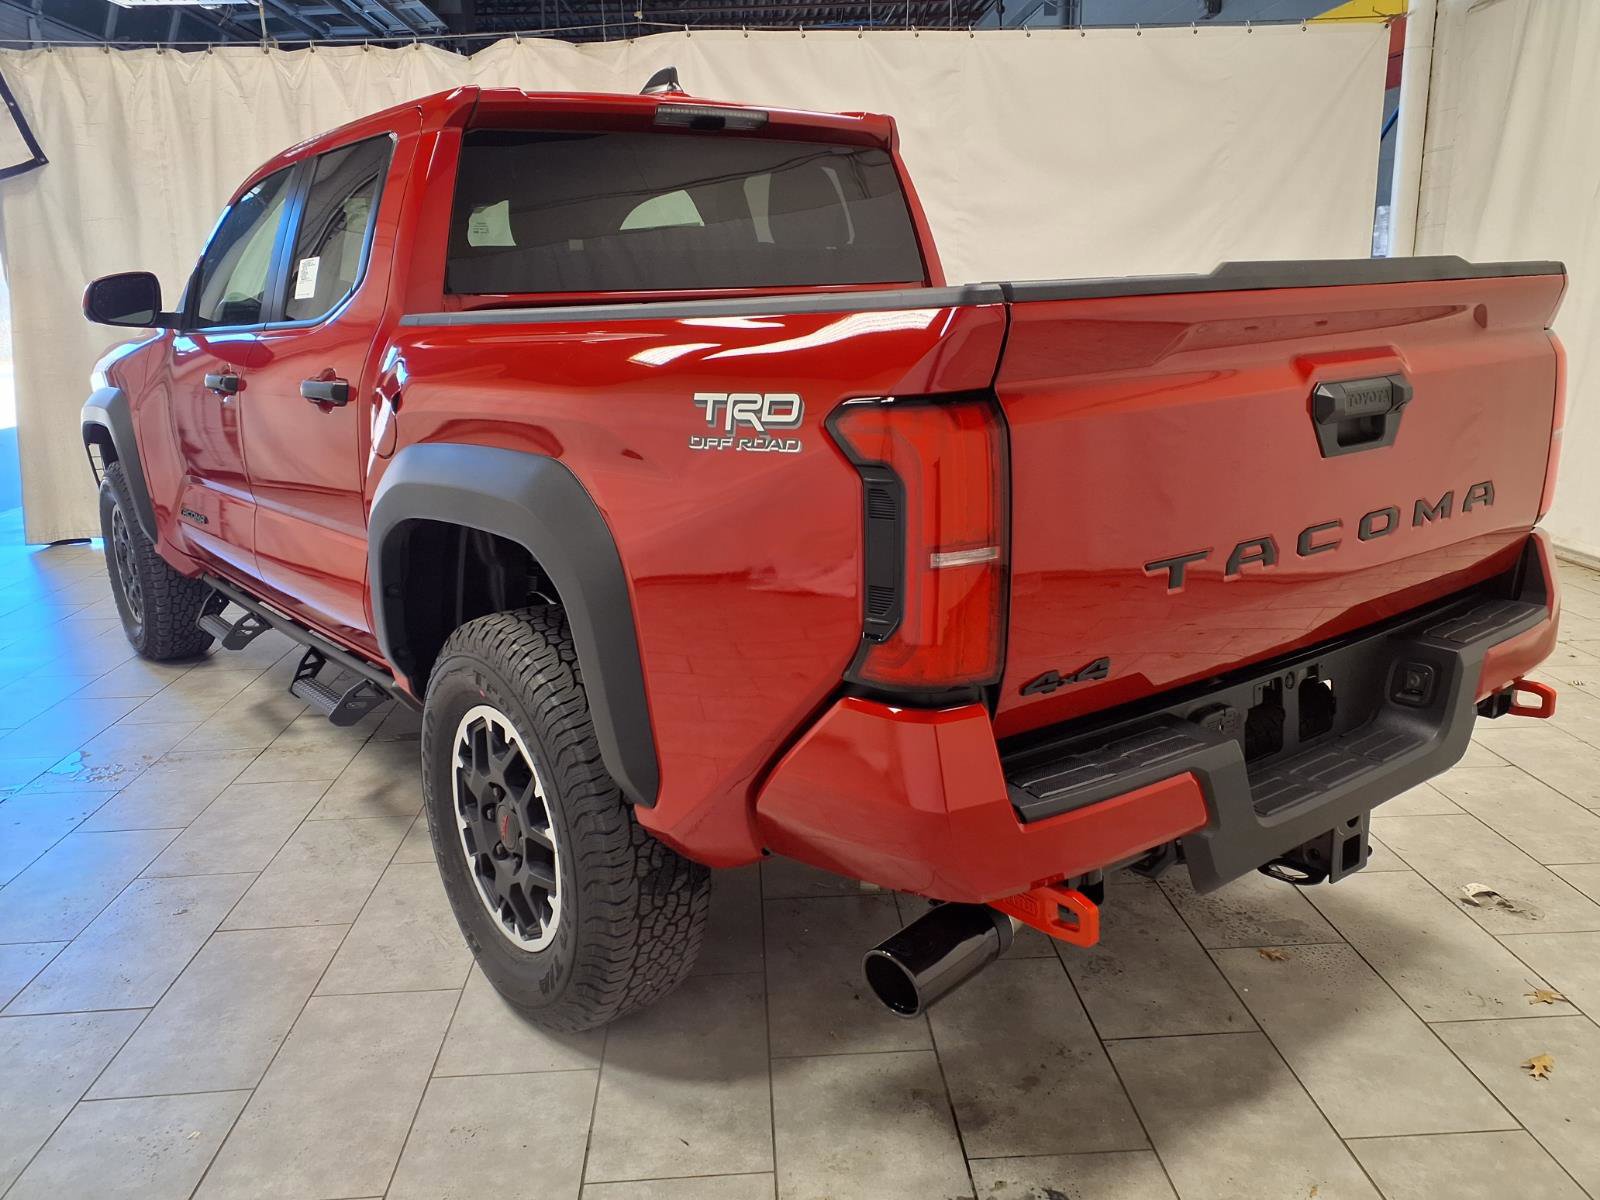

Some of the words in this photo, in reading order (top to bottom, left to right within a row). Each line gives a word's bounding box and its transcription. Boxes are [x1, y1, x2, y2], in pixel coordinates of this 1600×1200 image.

[1346, 387, 1390, 408] TOYOTA
[692, 391, 804, 438] TRD
[688, 436, 734, 451] OFF
[736, 438, 803, 453] ROAD
[181, 508, 208, 524] ACOMA
[1143, 479, 1496, 595] TACOMA
